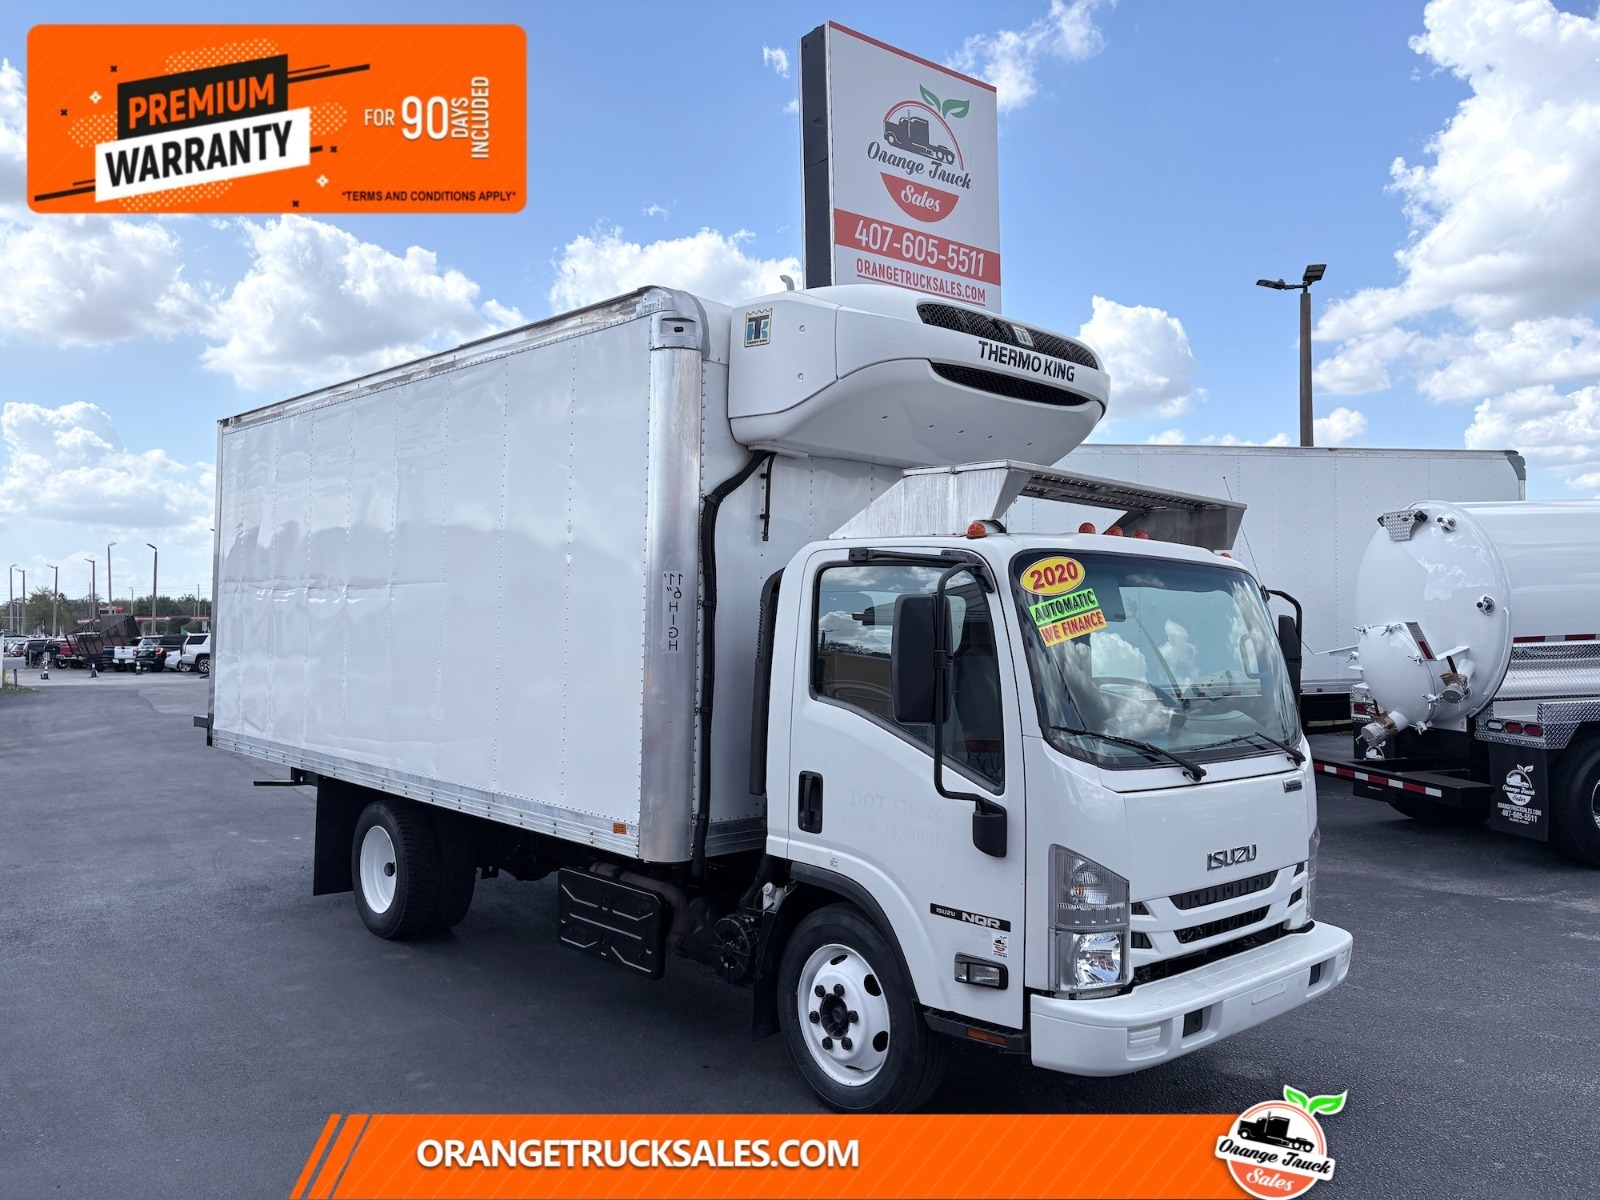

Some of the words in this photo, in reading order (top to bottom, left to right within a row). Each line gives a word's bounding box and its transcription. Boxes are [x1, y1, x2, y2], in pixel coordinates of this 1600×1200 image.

[867, 141, 925, 176] Orange
[928, 160, 972, 190] Truck
[900, 184, 941, 212] Sales
[854, 219, 985, 278] 407-605-5511
[856, 257, 986, 303] ORANGETRUCKSALES.COM
[978, 340, 1042, 373] THERMO
[1043, 358, 1075, 382] KING
[1030, 561, 1078, 590] 2020
[1034, 590, 1096, 622] AUTOMATIC
[1040, 624, 1062, 643] WE
[1061, 611, 1105, 637] FINANCE
[849, 789, 887, 811] DOT
[1207, 843, 1257, 871] ISUZU
[936, 907, 956, 917] ISUZU
[961, 912, 1000, 929] NQR
